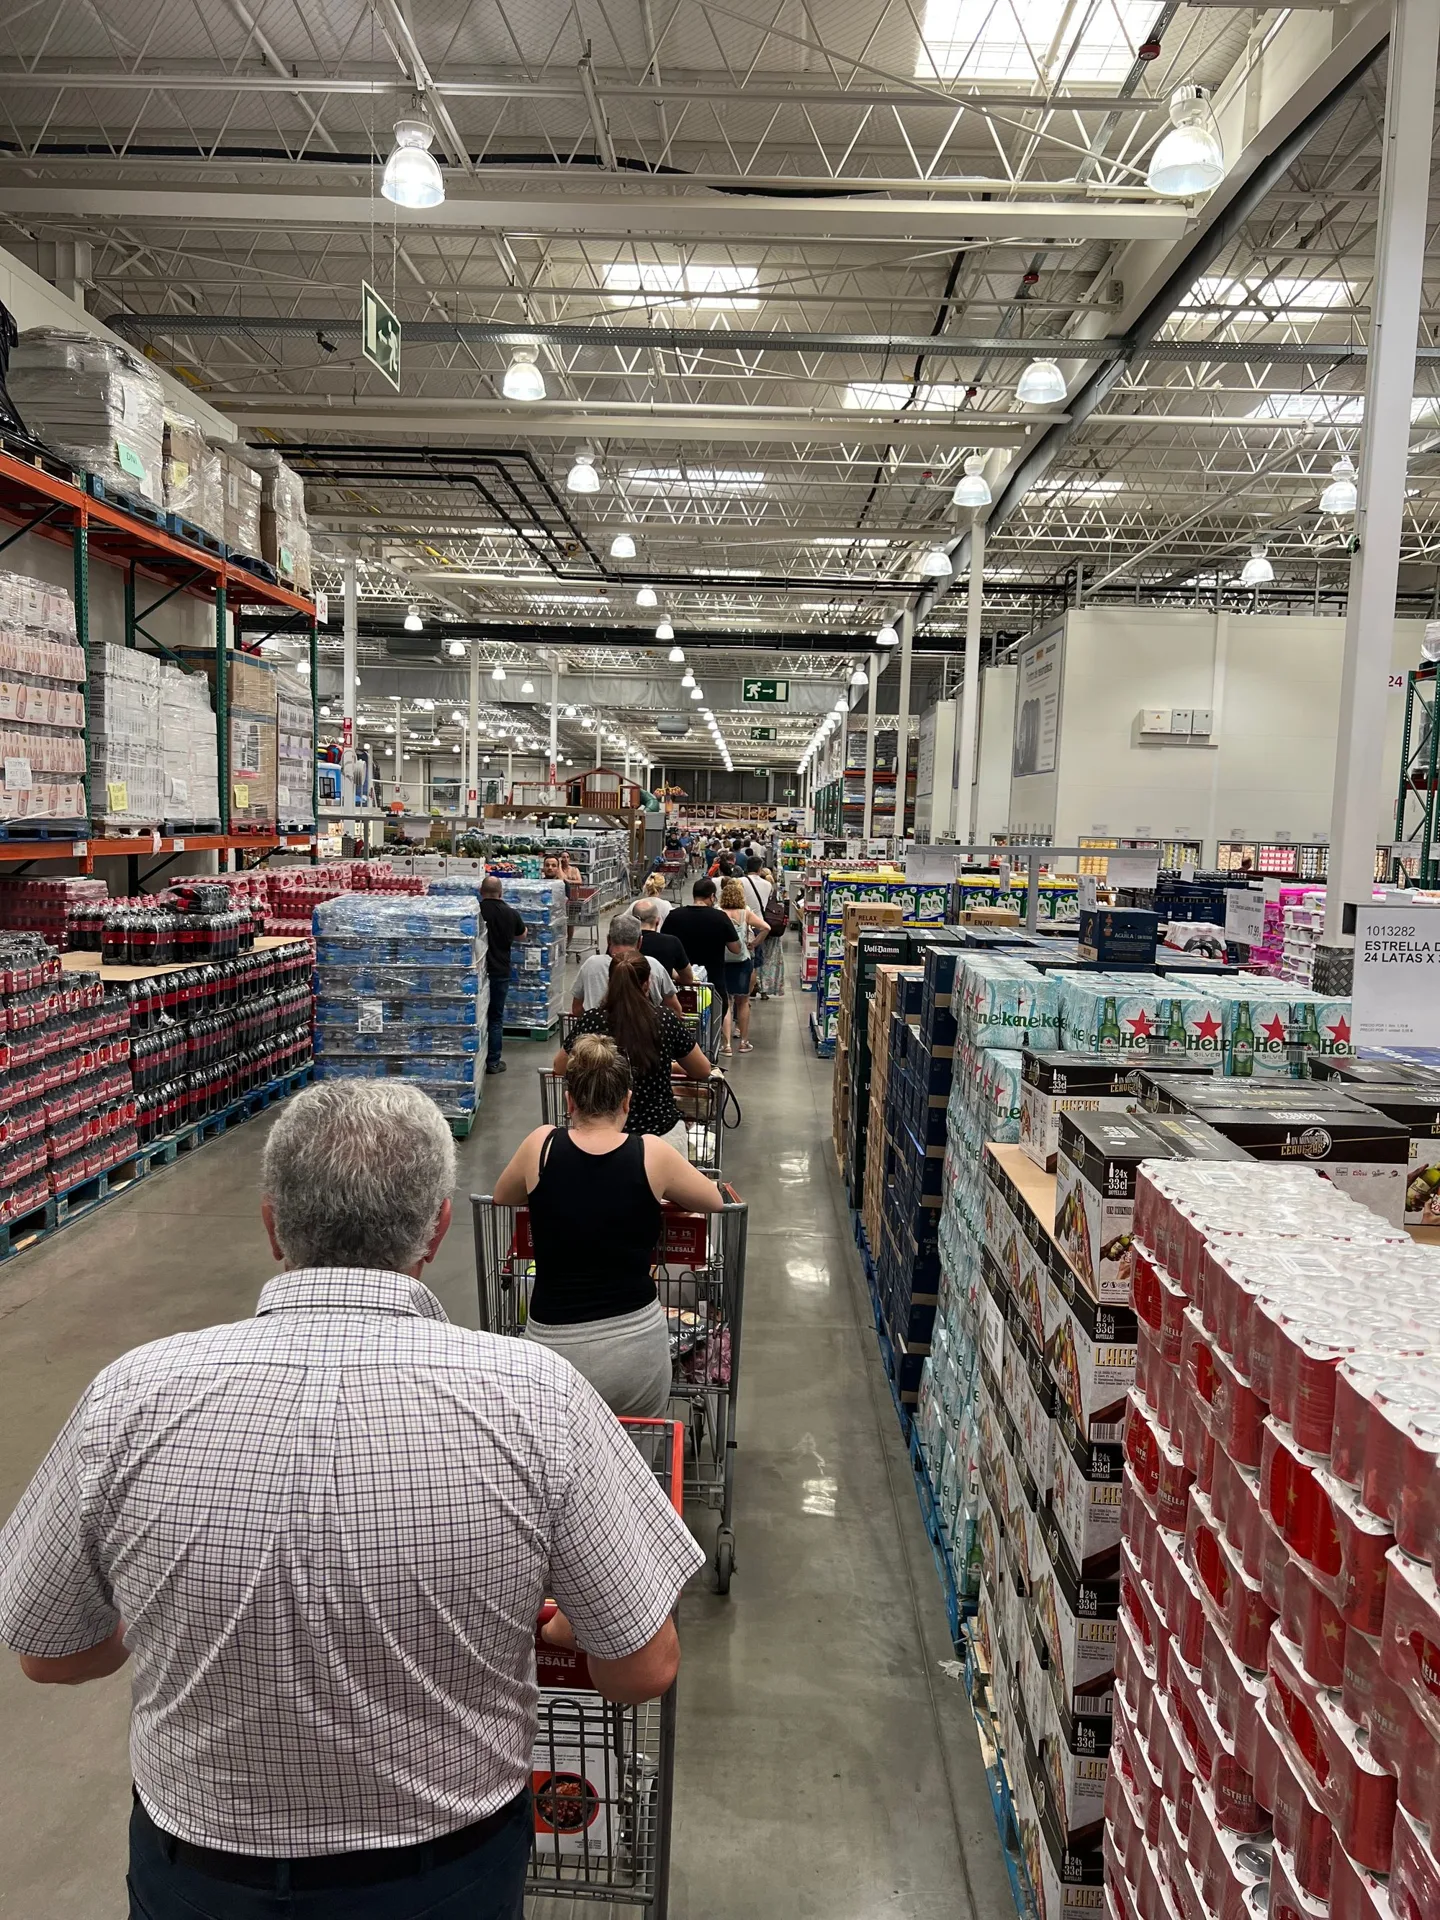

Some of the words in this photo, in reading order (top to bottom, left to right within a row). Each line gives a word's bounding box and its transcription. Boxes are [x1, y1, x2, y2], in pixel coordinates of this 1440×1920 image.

[1388, 675, 1403, 687] 24
[858, 914, 877, 922] RELAX
[974, 919, 994, 927] ENJOY
[1366, 925, 1416, 937] 1013282
[863, 944, 900, 954] Voll-Damm
[1365, 940, 1431, 952] ESTRELLA
[1364, 952, 1378, 963] 24
[1381, 952, 1423, 963] LATAS
[1426, 953, 1435, 963] X
[1052, 1080, 1067, 1090] 33cl
[1114, 1168, 1128, 1179] 24x
[1108, 1178, 1128, 1190] 33cl
[1102, 1313, 1115, 1323] 24x
[1096, 1323, 1115, 1334] 33cl
[1095, 1348, 1137, 1367] LAGE
[1098, 1453, 1111, 1462] 24x
[1092, 1462, 1110, 1473] 33cl
[1085, 1590, 1098, 1600] 24x
[1078, 1599, 1097, 1610] 33cl
[1083, 1728, 1096, 1738] 24x
[1076, 1737, 1095, 1748] 33cl
[1070, 1857, 1083, 1866] 24x
[1064, 1866, 1082, 1876] 33cl
